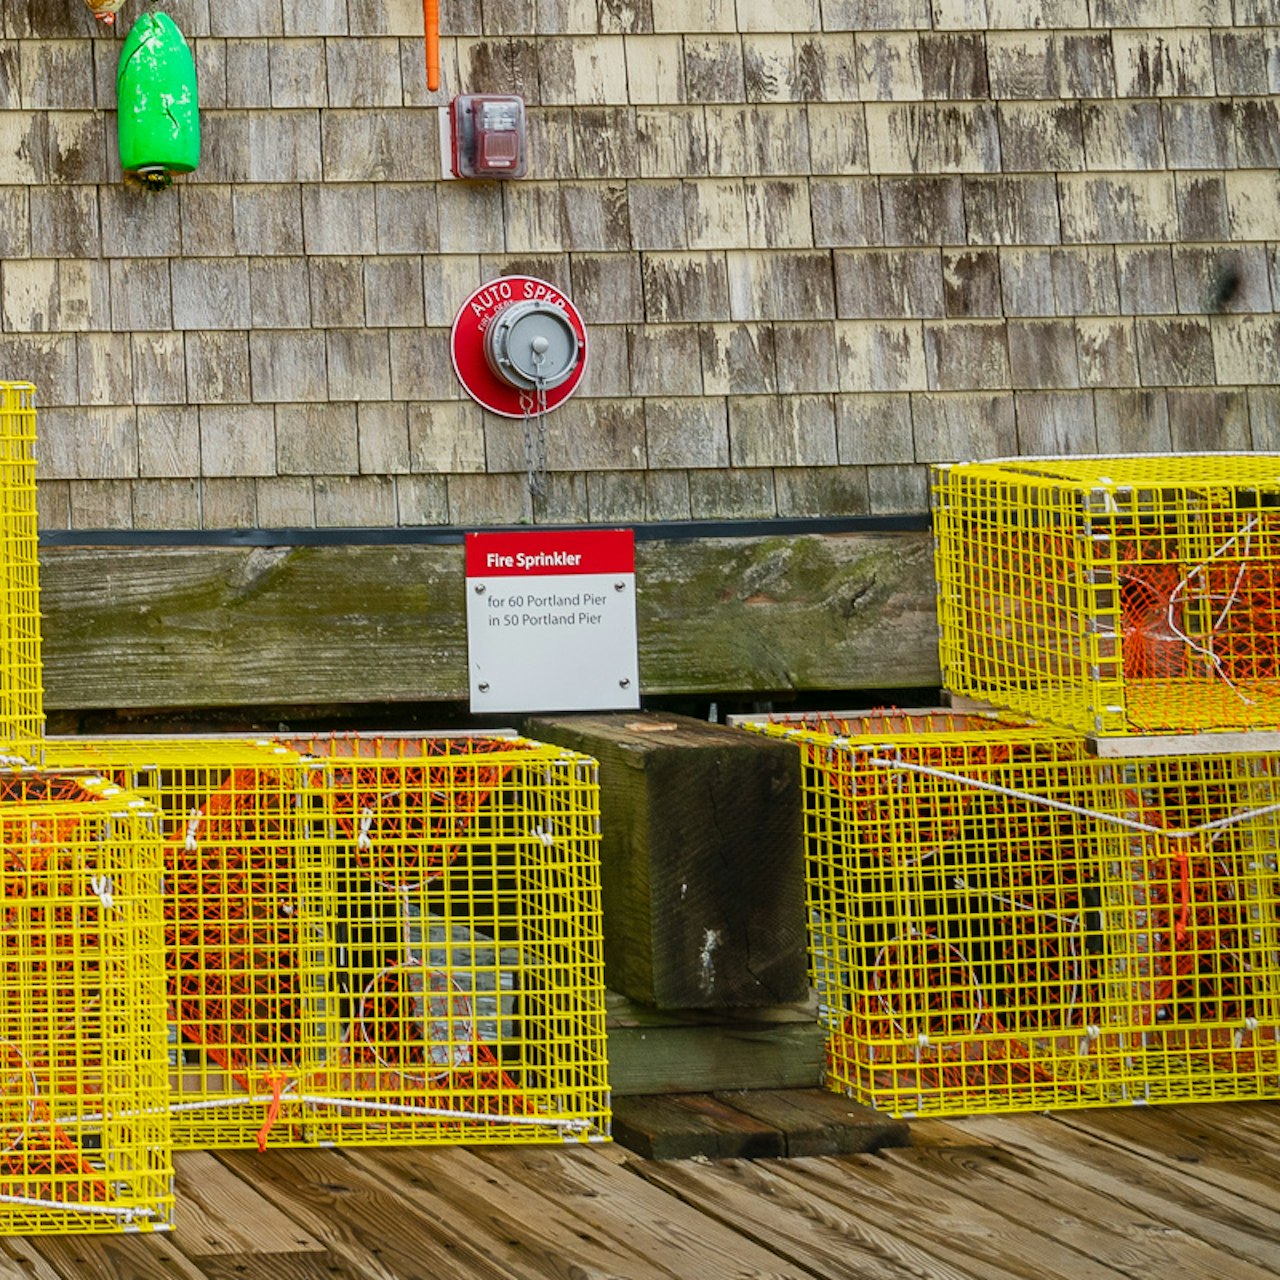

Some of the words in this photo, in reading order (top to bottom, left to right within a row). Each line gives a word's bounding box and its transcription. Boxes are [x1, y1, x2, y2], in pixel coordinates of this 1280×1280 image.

[471, 282, 512, 317] AUTO
[486, 553, 514, 568] Fire
[516, 551, 582, 570] Sprinkler
[487, 595, 504, 608] for
[508, 595, 524, 608] 60
[527, 593, 580, 607] Portland
[583, 593, 608, 606] Pier
[488, 614, 500, 626] in
[504, 614, 519, 626] 50
[522, 612, 575, 626] Portland
[578, 612, 602, 625] Pier
